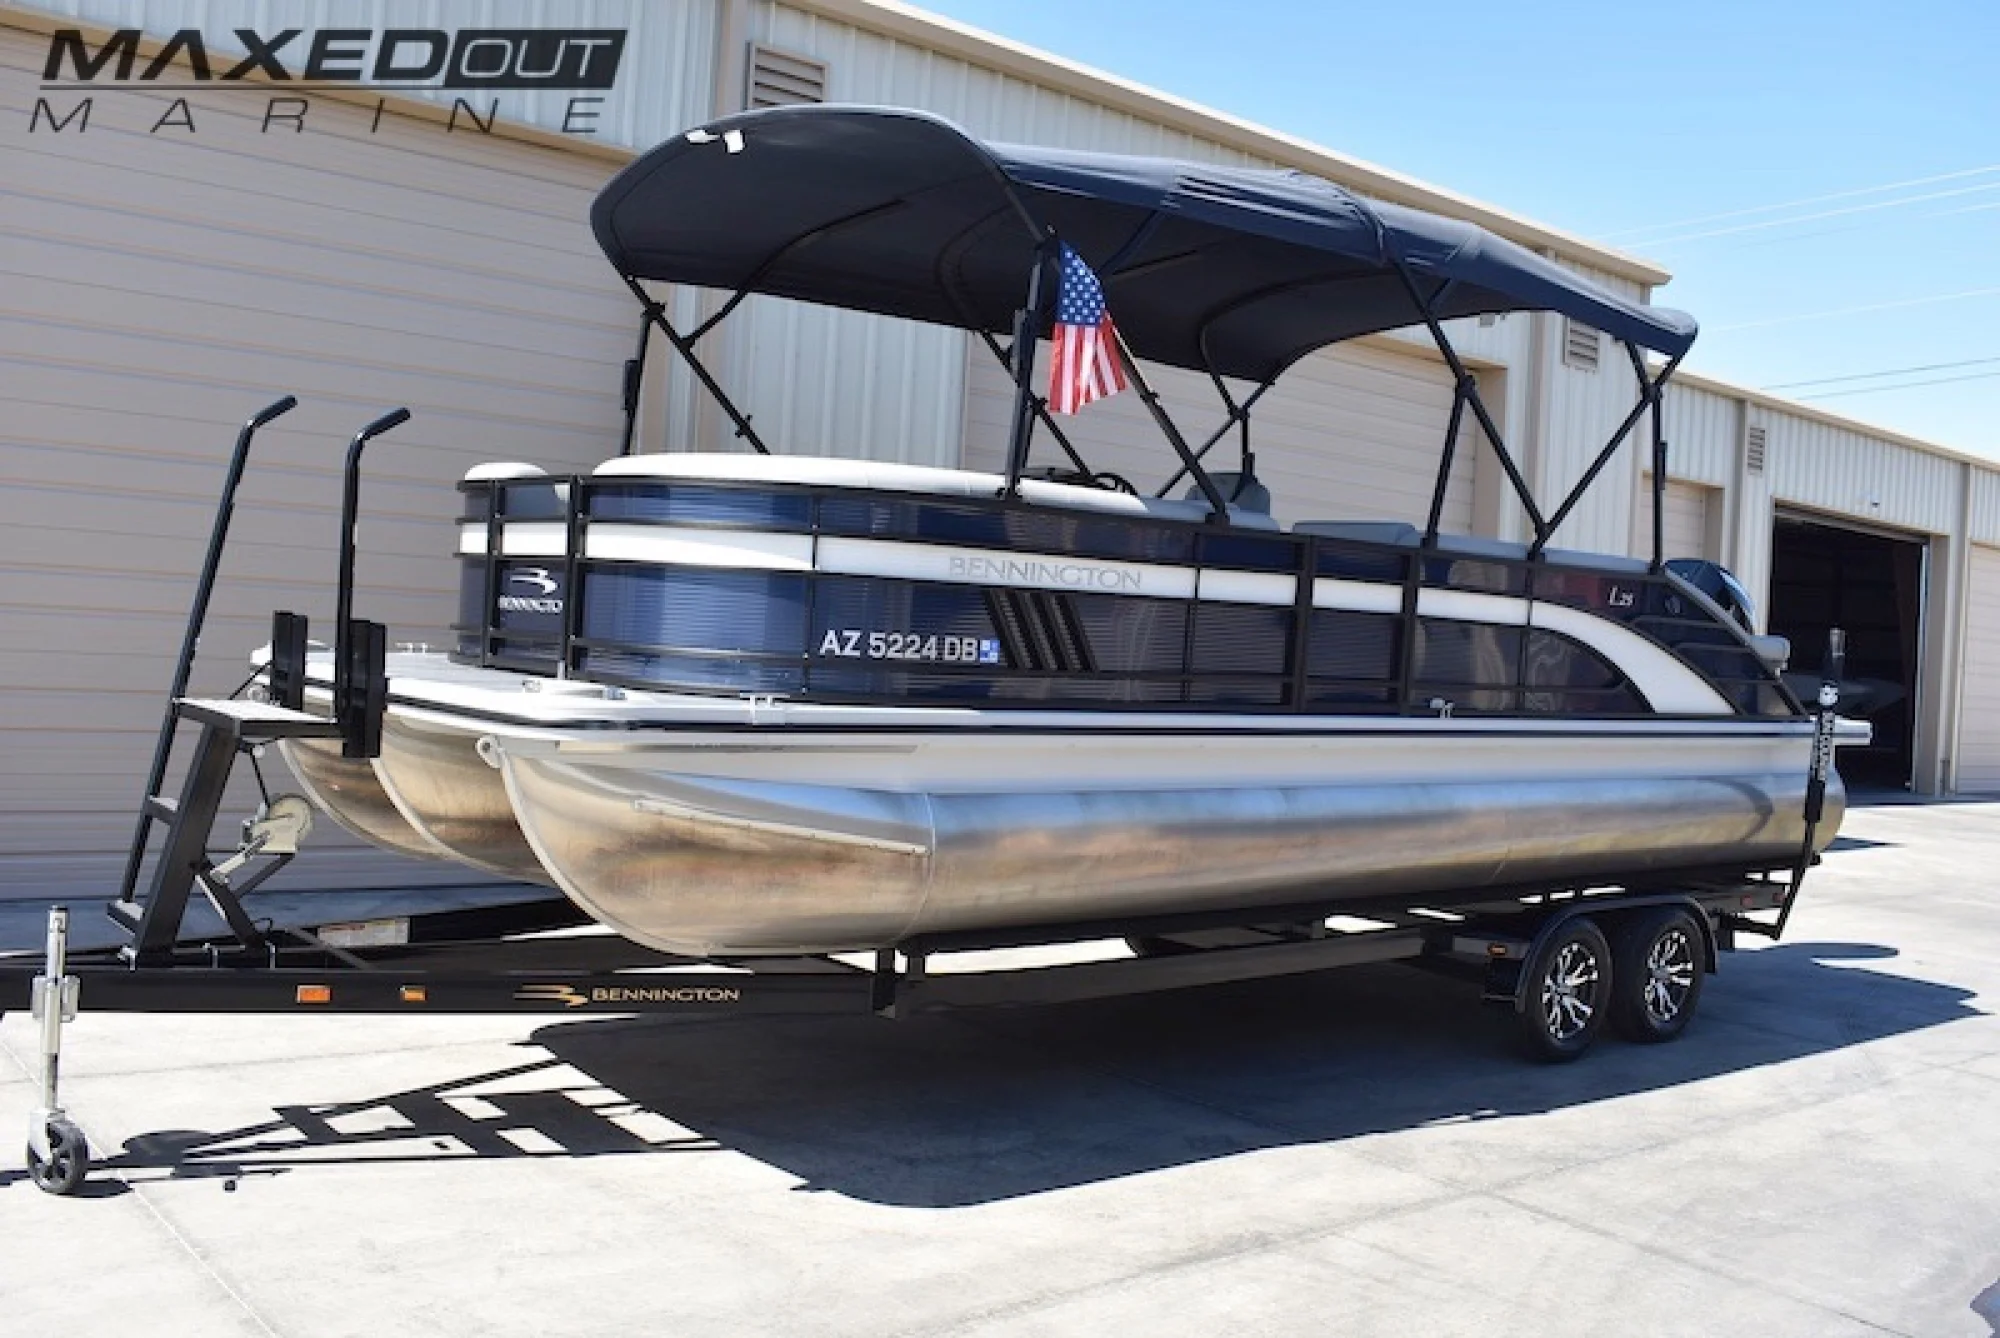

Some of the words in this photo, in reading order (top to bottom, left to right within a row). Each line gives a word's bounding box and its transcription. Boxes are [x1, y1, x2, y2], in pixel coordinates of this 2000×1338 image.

[949, 556, 1142, 590] BENNINGTON
[819, 629, 862, 657] AZ
[868, 632, 938, 661] 5224
[944, 637, 978, 661] DB
[592, 986, 740, 1002] BENNINGTON
